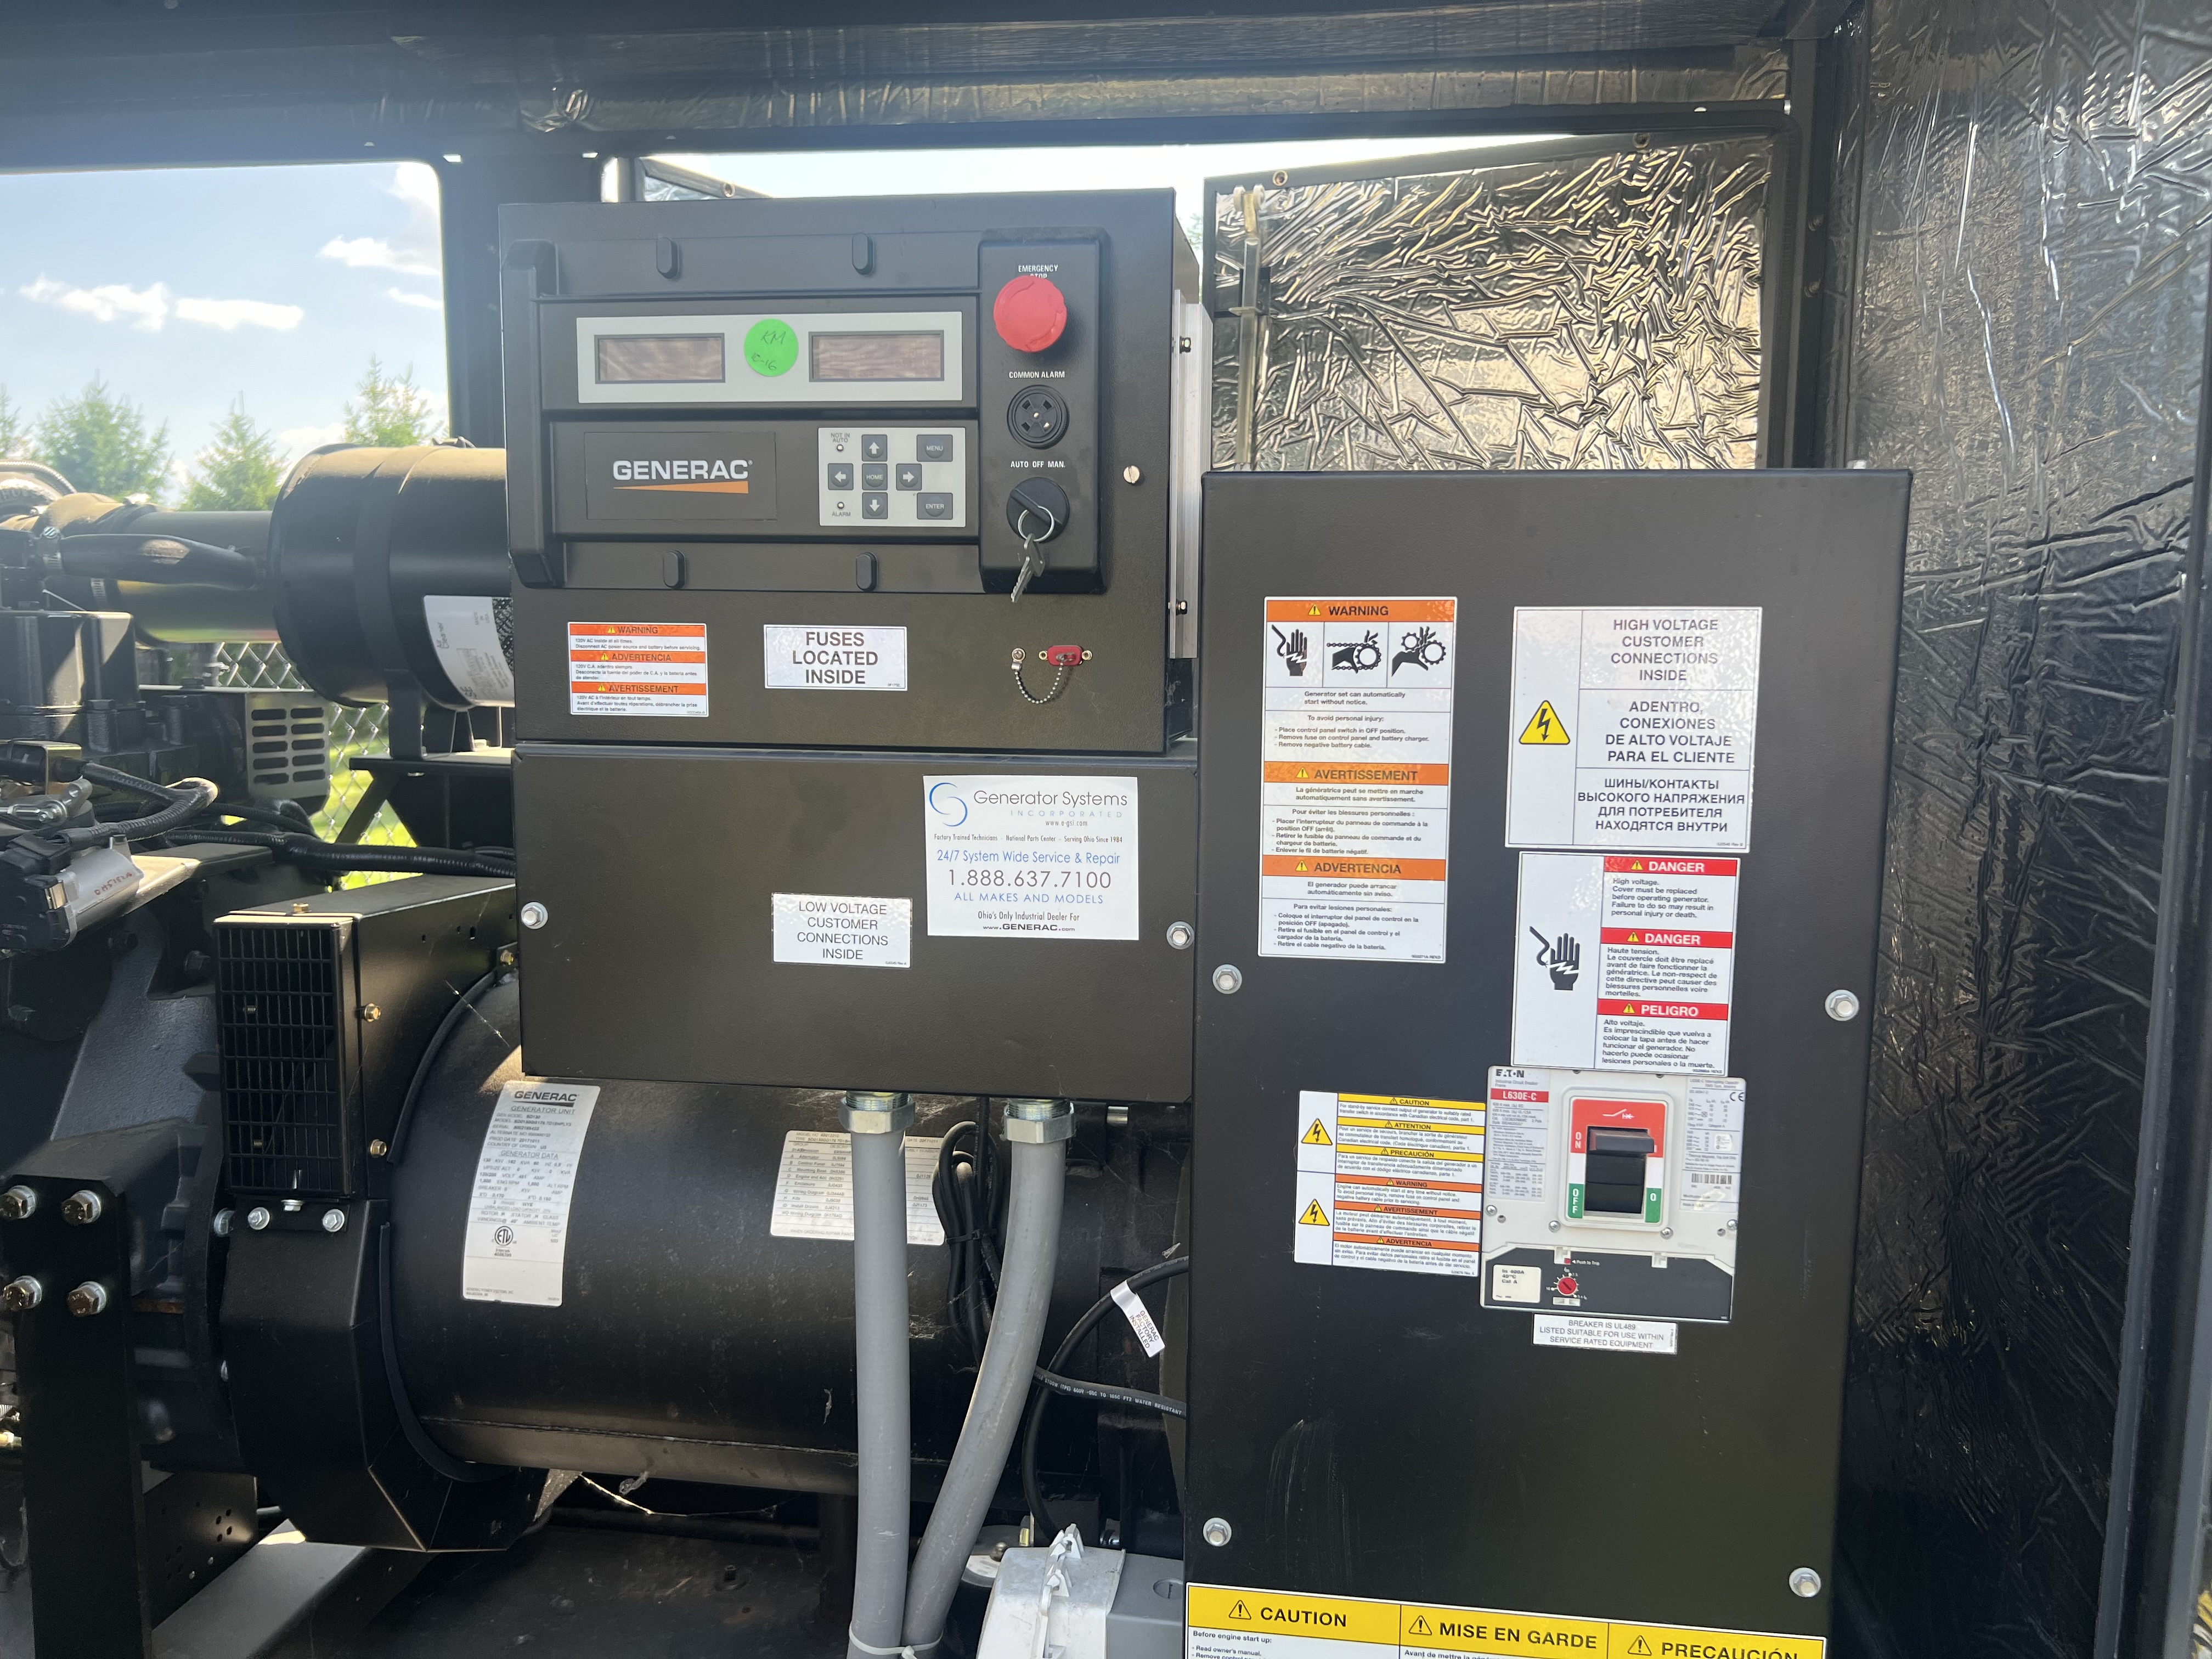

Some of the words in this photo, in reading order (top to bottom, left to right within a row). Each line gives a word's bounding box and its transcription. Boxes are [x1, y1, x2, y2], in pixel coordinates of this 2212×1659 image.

[1018, 264, 1058, 272] EMERGENCY
[761, 331, 786, 345] KM
[1008, 371, 1040, 379] COMMON
[613, 460, 749, 480] GENERAC
[1329, 606, 1389, 616] WARNING
[1613, 619, 1649, 631] HIGH
[1653, 619, 1718, 631] VOLTAGE
[806, 631, 865, 646] FUSES
[1622, 636, 1703, 647] CUSTOMER
[792, 651, 878, 666] LOCATED
[1611, 653, 1718, 664] CONNECTIONS
[806, 669, 866, 685] INSIDE
[1639, 670, 1687, 681] INSIDE
[1629, 701, 1703, 715] ADENTRO,
[1620, 718, 1716, 729] CONEXIONES
[1606, 734, 1625, 745] DE
[1629, 735, 1665, 746] ALTO
[1669, 735, 1731, 747] VOLTAJE
[1607, 751, 1646, 762] PARA
[1651, 752, 1669, 763] EL
[1673, 752, 1735, 764] CLIENTE
[1314, 770, 1418, 781] AVERTISSEMENT
[1605, 778, 1719, 790] ШИНЫ/КОНТАКТЫ
[974, 790, 1058, 805] Generator
[1062, 791, 1127, 808] Systems
[1578, 792, 1650, 803] ВЫСОКОГО
[1654, 793, 1745, 804] НАПРЯЖЕНИЯ
[1011, 810, 1122, 818] INCORPORATED
[1598, 806, 1625, 817] ДЛЯ
[1629, 807, 1722, 819] ПОТРЕБИТЕЛЯ
[1595, 820, 1673, 832] НАХОДЯТСЯ
[1677, 821, 1728, 833] ВНУТРИ
[937, 849, 959, 862] 24/7
[963, 850, 999, 865] System
[1003, 851, 1029, 863] Wide
[1032, 852, 1070, 864] Service
[1075, 853, 1082, 863] &
[1086, 853, 1120, 866] Repair
[1314, 862, 1401, 874] ADVERTENCIA
[1649, 861, 1705, 872] DANGER
[949, 869, 1111, 888] 1.888.637.7100
[954, 892, 974, 901] ALL
[979, 893, 1018, 902] MAKES
[1024, 894, 1049, 902] AND
[1055, 895, 1103, 904] MODELS
[799, 901, 826, 912] LOW
[831, 903, 887, 915] VOLTAGE
[978, 911, 997, 919] Ohio's
[999, 912, 1013, 921] Only
[1015, 912, 1045, 921] Industrial
[1047, 913, 1068, 922] Dealer
[1070, 913, 1080, 922] For
[808, 917, 878, 929] CUSTOMER
[798, 932, 888, 945] CONNECTIONS
[1645, 933, 1701, 945] DANGER
[823, 949, 864, 960] INSIDE
[1641, 1005, 1699, 1017] PELIGRO
[514, 1091, 577, 1101] GENERAC
[1503, 1091, 1537, 1101] L630E-C
[1575, 1131, 1582, 1149] ON
[1390, 1149, 1434, 1158] PRECAUCIÓN
[1384, 1206, 1438, 1215] AVERTISSEMENT
[1386, 1238, 1432, 1246] ADVERTENCIA
[1129, 1315, 1150, 1348] INSTALLED
[1136, 1313, 1154, 1343] FACTORY
[1140, 1310, 1159, 1341] GENERAC
[1567, 1328, 1602, 1336] SUITABLE
[1638, 1333, 1664, 1341] WITHIN
[1610, 1340, 1653, 1348] EQUIPMENT
[1135, 1398, 1152, 1406] WATER
[1154, 1402, 1182, 1415] RESISTANT
[1260, 1607, 1347, 1627] CAUTION
[1440, 1621, 1487, 1639] MISE
[1494, 1627, 1520, 1643] EN
[1527, 1630, 1598, 1649] GARDE
